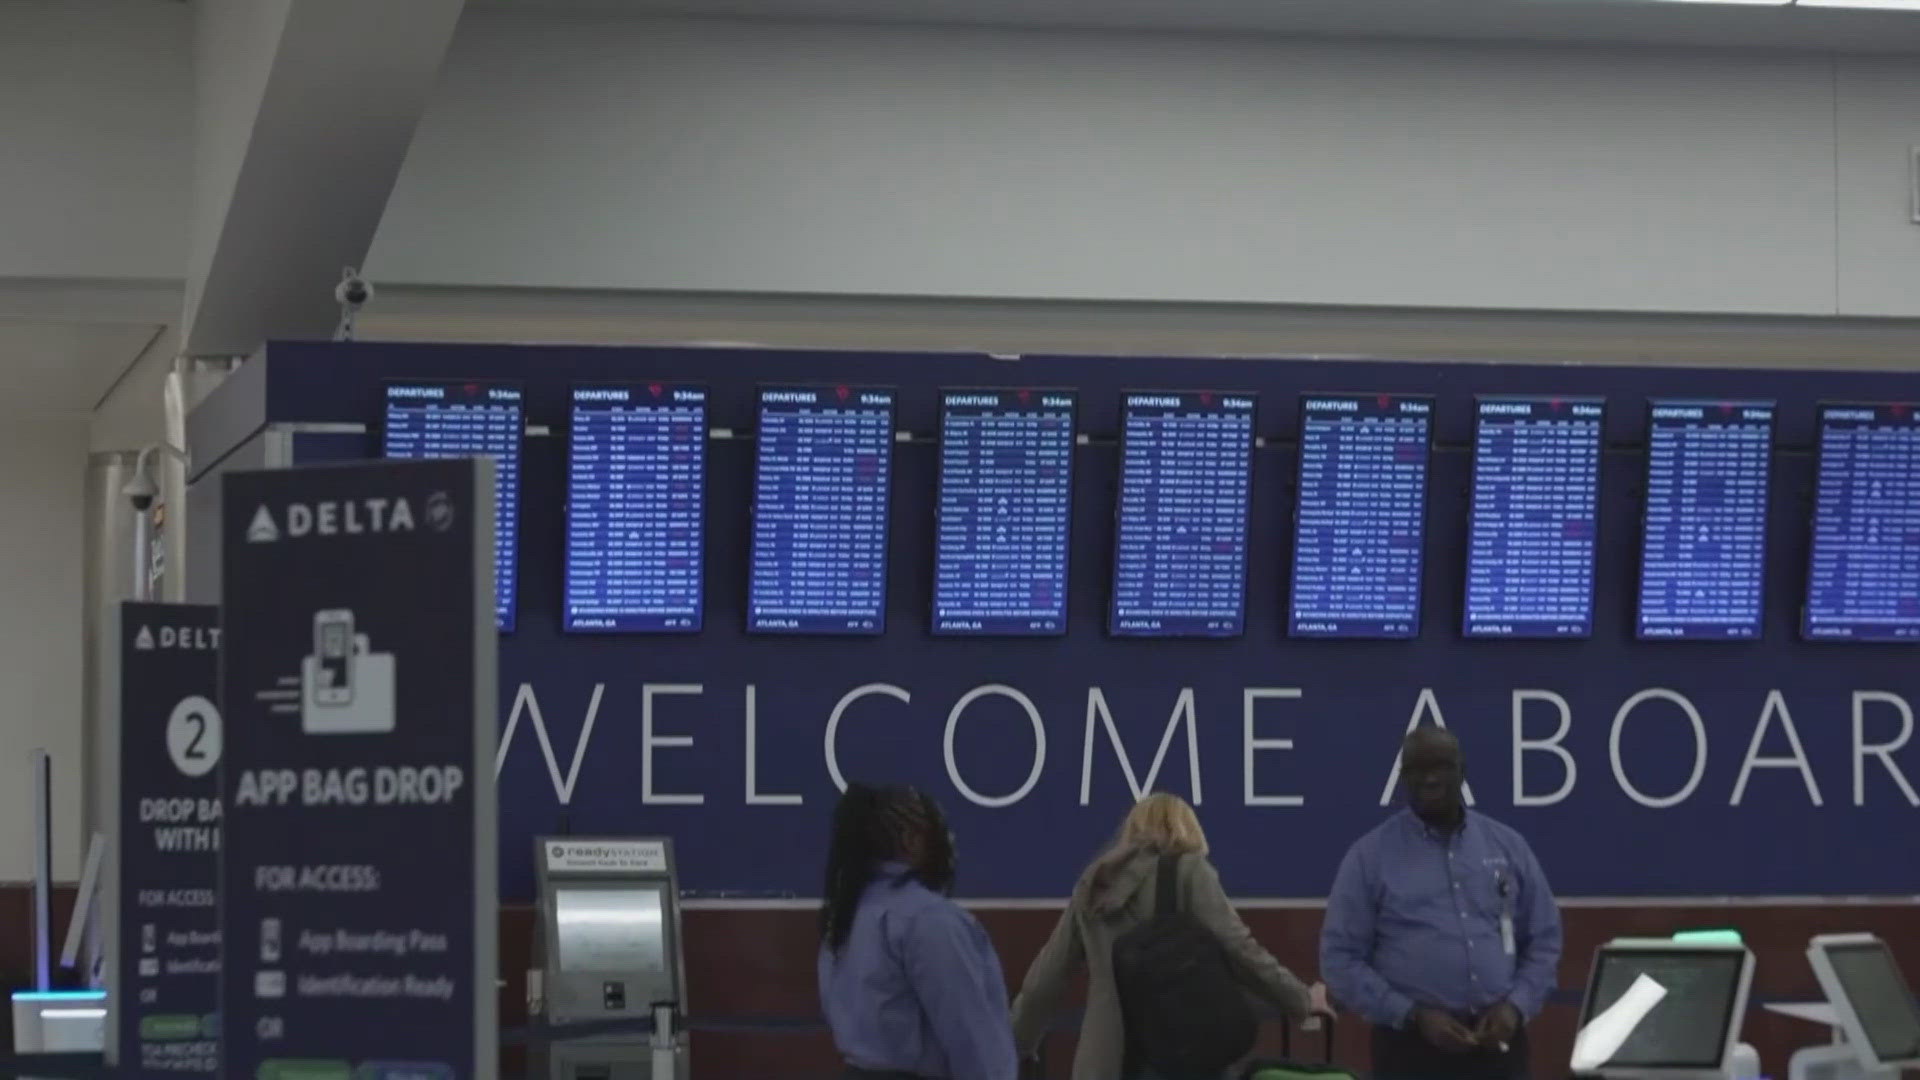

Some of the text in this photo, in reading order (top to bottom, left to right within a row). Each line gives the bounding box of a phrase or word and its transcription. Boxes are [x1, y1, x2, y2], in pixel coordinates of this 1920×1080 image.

[387, 387, 444, 398] DEPARTURES
[488, 389, 520, 400] 9:34am
[574, 390, 629, 400] DEPARTURES
[673, 391, 705, 401] 9:34am
[762, 392, 817, 403] DEPARTURES
[860, 393, 891, 404] 9:34am
[945, 396, 998, 406] DEPARTURES
[1042, 396, 1072, 407] 9:34am
[1127, 396, 1180, 407] DEPARTURES
[1306, 400, 1358, 411] DEPARTURES
[1480, 404, 1531, 414] DEPARTURES
[288, 498, 415, 536] DELTA
[606, 619, 616, 628] GA
[788, 619, 799, 628] GA
[972, 621, 982, 630] GA
[1151, 620, 1161, 629] GA
[184, 711, 206, 759] 2
[494, 683, 1304, 807] WELCOME
[236, 765, 464, 806] APP BAG DROP
[139, 799, 195, 822] DROP
[155, 828, 209, 850] WITH
[255, 865, 381, 891] FOR ACCESS:
[139, 889, 164, 906] FOR
[300, 928, 447, 956] App Boarding Pass
[298, 974, 454, 1002] Identification Ready
[140, 989, 157, 1002] OR
[256, 1017, 283, 1038] OR
